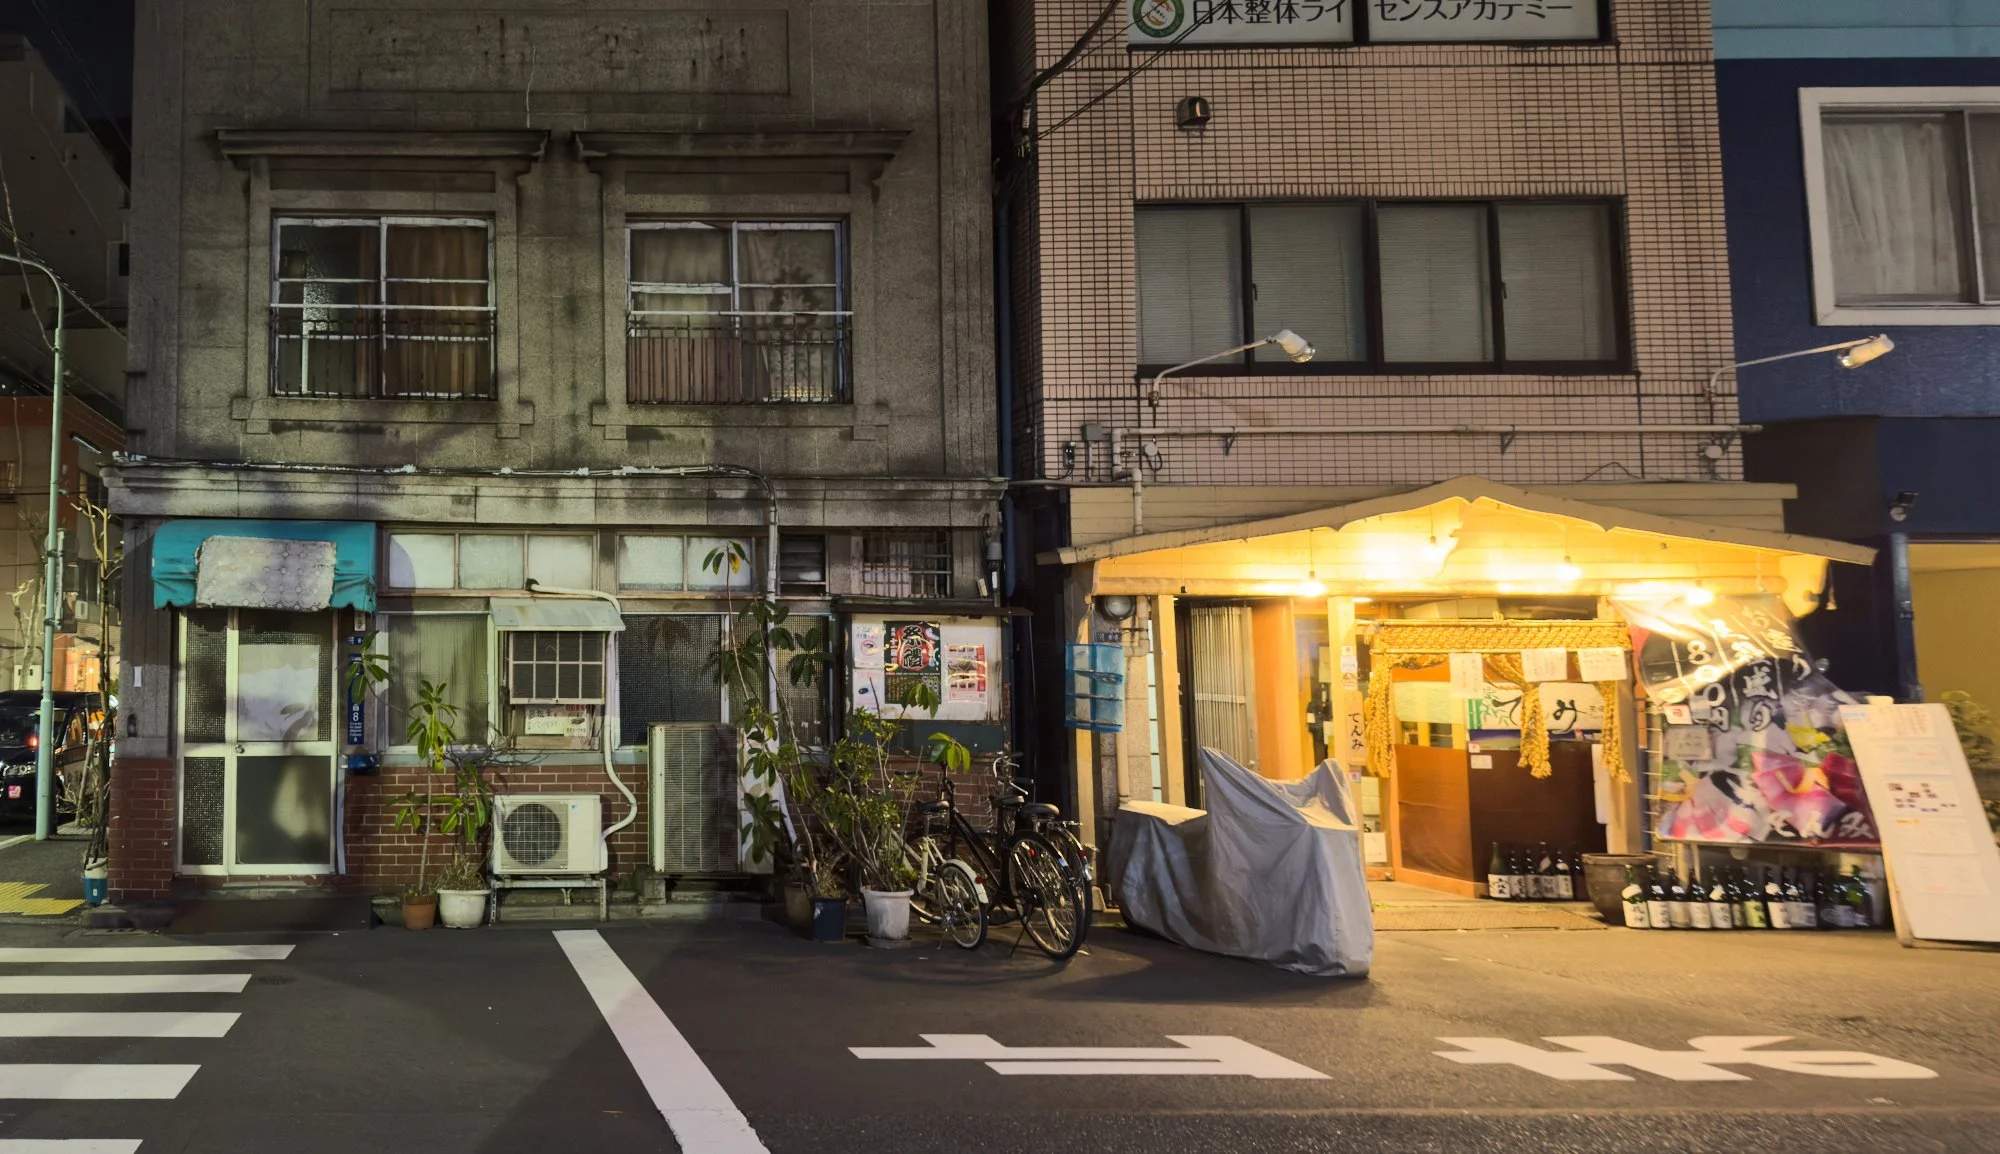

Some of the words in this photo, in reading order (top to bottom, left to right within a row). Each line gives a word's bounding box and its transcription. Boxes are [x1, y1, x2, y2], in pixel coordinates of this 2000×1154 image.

[1193, 0, 1347, 25] 日本整体ライ
[1373, 0, 1573, 22] センスアカデミー
[352, 711, 360, 722] 8
[1348, 711, 1365, 751] てんみ
[1491, 695, 1586, 735] てみ
